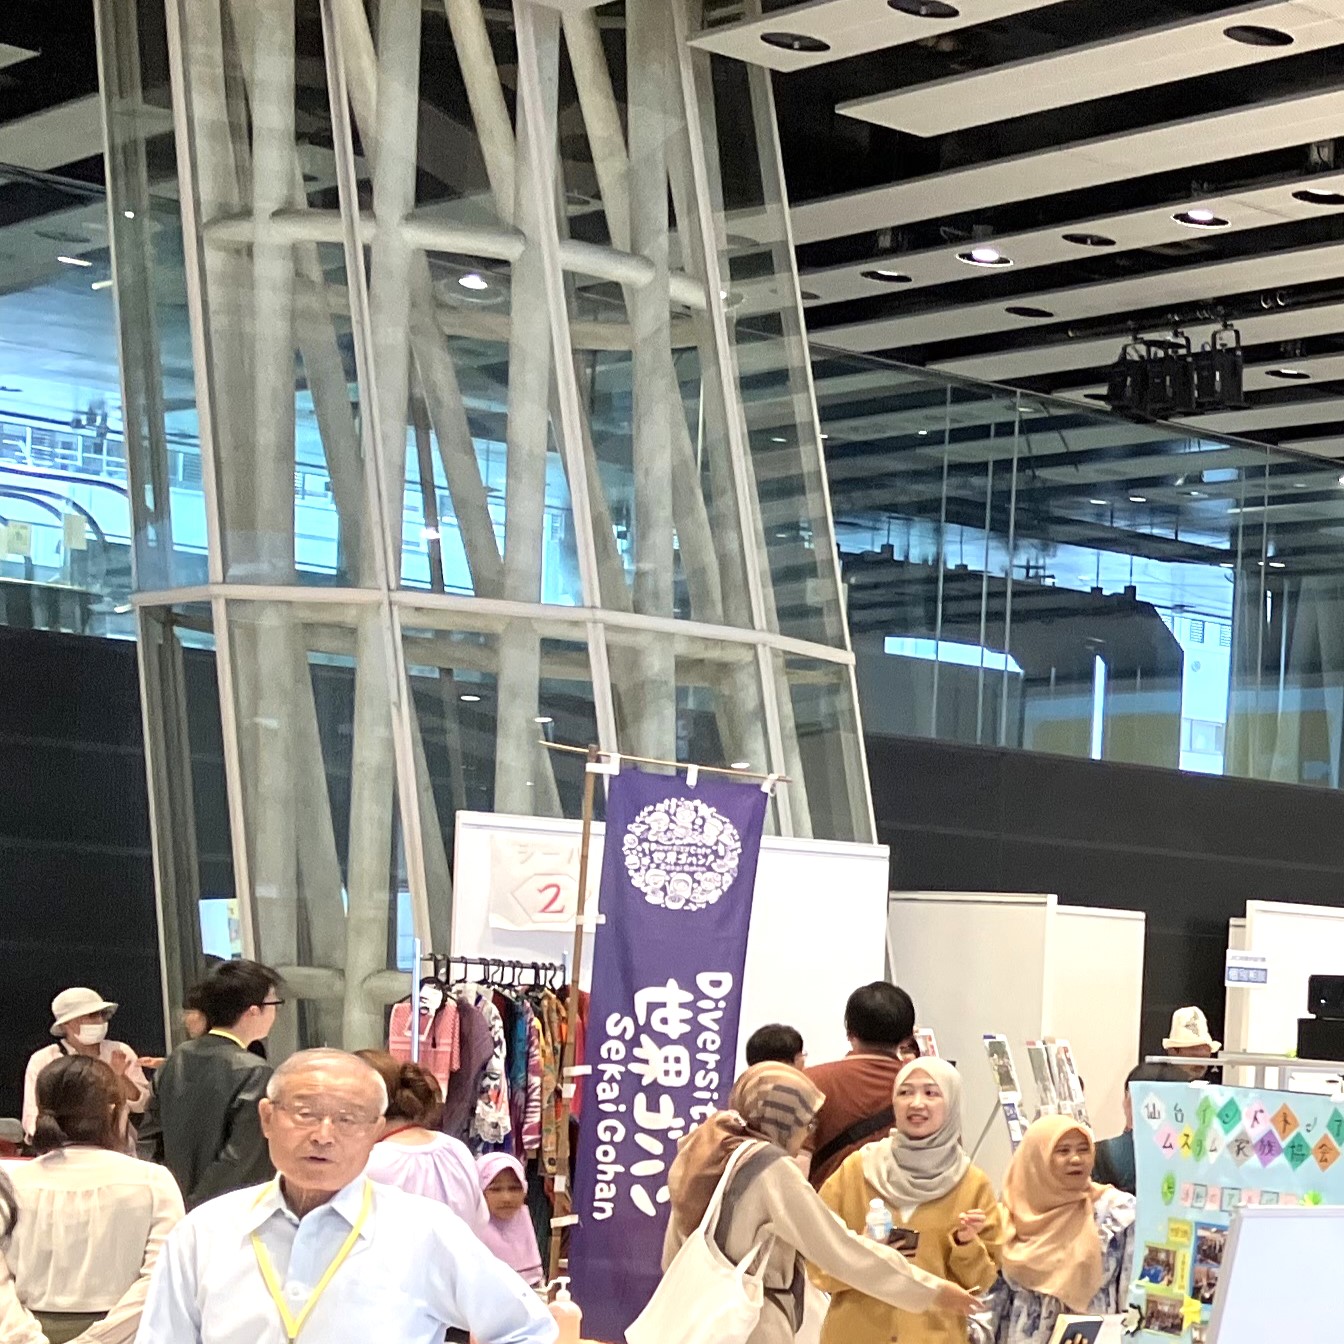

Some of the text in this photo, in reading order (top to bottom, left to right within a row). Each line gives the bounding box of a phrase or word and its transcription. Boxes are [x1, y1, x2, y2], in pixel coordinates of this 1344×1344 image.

[537, 882, 565, 914] 2
[592, 1012, 635, 1221] Sekai Gohan
[689, 971, 733, 1134] Diversit
